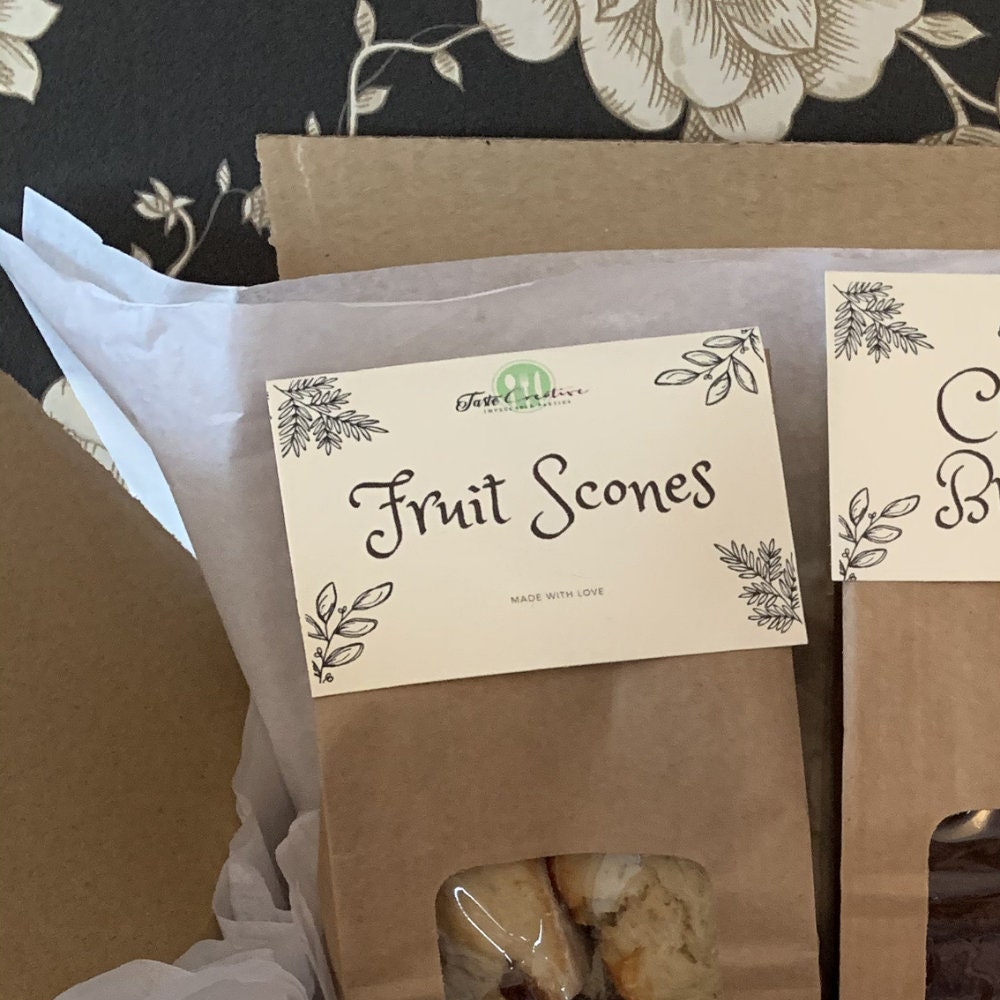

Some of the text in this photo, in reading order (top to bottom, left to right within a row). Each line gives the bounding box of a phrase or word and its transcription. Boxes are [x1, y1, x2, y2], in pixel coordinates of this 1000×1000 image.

[455, 390, 503, 412] Taste
[349, 452, 716, 559] Fruit Scones
[510, 587, 604, 604] MADE WITH LOVE
